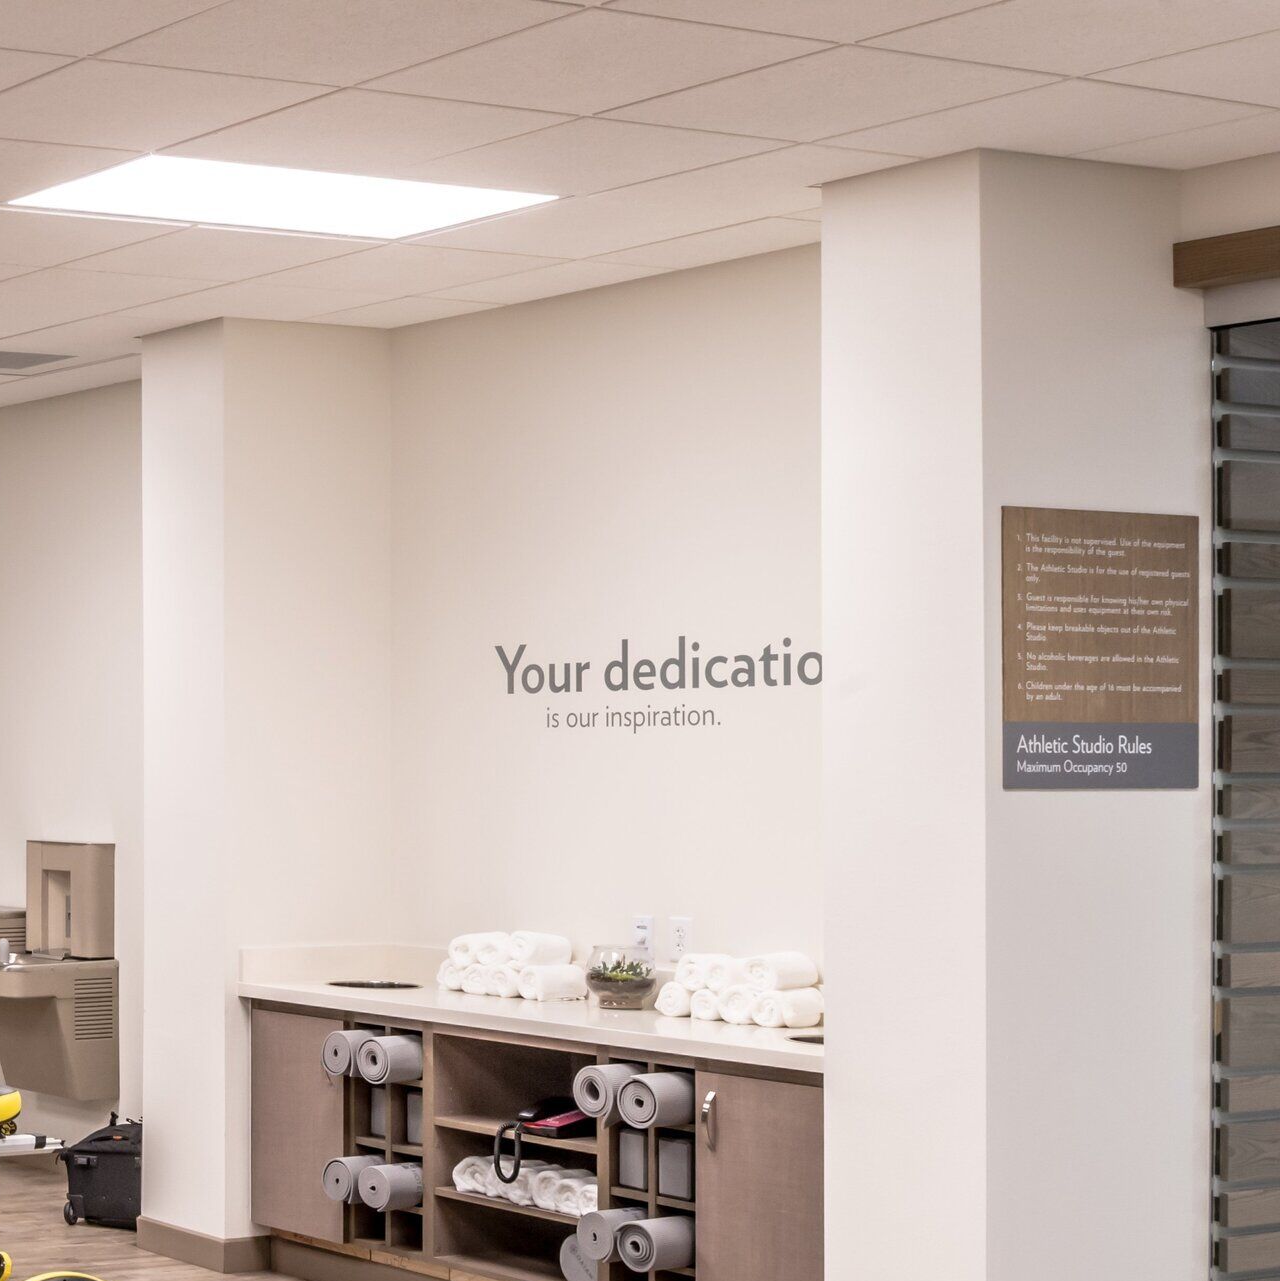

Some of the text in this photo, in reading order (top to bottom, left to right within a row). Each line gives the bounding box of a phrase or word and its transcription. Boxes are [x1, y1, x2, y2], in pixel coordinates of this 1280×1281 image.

[1026, 533, 1040, 542] This
[1042, 534, 1062, 544] facility
[1064, 536, 1069, 544] is
[1120, 538, 1132, 546] Use
[1141, 539, 1151, 547] the
[1153, 542, 1185, 550] equipment
[1032, 544, 1042, 552] the
[1044, 546, 1085, 556] responsibility
[1087, 546, 1094, 555] of
[1096, 547, 1106, 555] the
[1025, 574, 1040, 583] only.
[1026, 563, 1038, 571] The
[1041, 564, 1065, 573] Athletic
[1067, 565, 1087, 573] Studio
[1096, 565, 1105, 574] for
[1107, 567, 1117, 575] the
[1130, 567, 1138, 575] of
[1171, 571, 1190, 580] guests
[1026, 592, 1045, 601] Guest
[1054, 595, 1089, 604] responsible
[1090, 595, 1099, 603] for
[1101, 595, 1127, 606] knowing
[1165, 597, 1189, 607] physical
[1060, 604, 1072, 613] and
[1088, 608, 1121, 616] equipment
[1131, 607, 1145, 615] their
[1026, 621, 1046, 631] Please
[1048, 623, 1063, 633] keep
[1065, 623, 1095, 632] breakable
[1096, 624, 1119, 635] objects
[1133, 625, 1140, 634] of
[1141, 625, 1151, 634] the
[1153, 626, 1176, 635] Athletic
[1026, 652, 1036, 661] No
[1038, 652, 1066, 661] alcoholic
[1068, 652, 1099, 664] beverages
[1112, 654, 1135, 663] allowed
[1137, 655, 1142, 663] in
[1144, 655, 1154, 664] the
[1155, 655, 1179, 664] Athletic
[495, 644, 590, 694] Your
[1026, 661, 1048, 671] Studio.
[1026, 681, 1053, 690] Children
[1054, 682, 1072, 691] under
[1074, 682, 1084, 691] the
[1086, 685, 1098, 693] age
[1099, 682, 1106, 691] of
[1132, 683, 1141, 692] be
[1142, 684, 1182, 694] accompanied
[1026, 692, 1034, 702] by
[1045, 692, 1063, 701] adult.
[547, 703, 721, 734] is our inspiration.
[1017, 734, 1152, 754] Athletic Studio Rules
[1017, 759, 1128, 776] Maximum Occupancy 50
